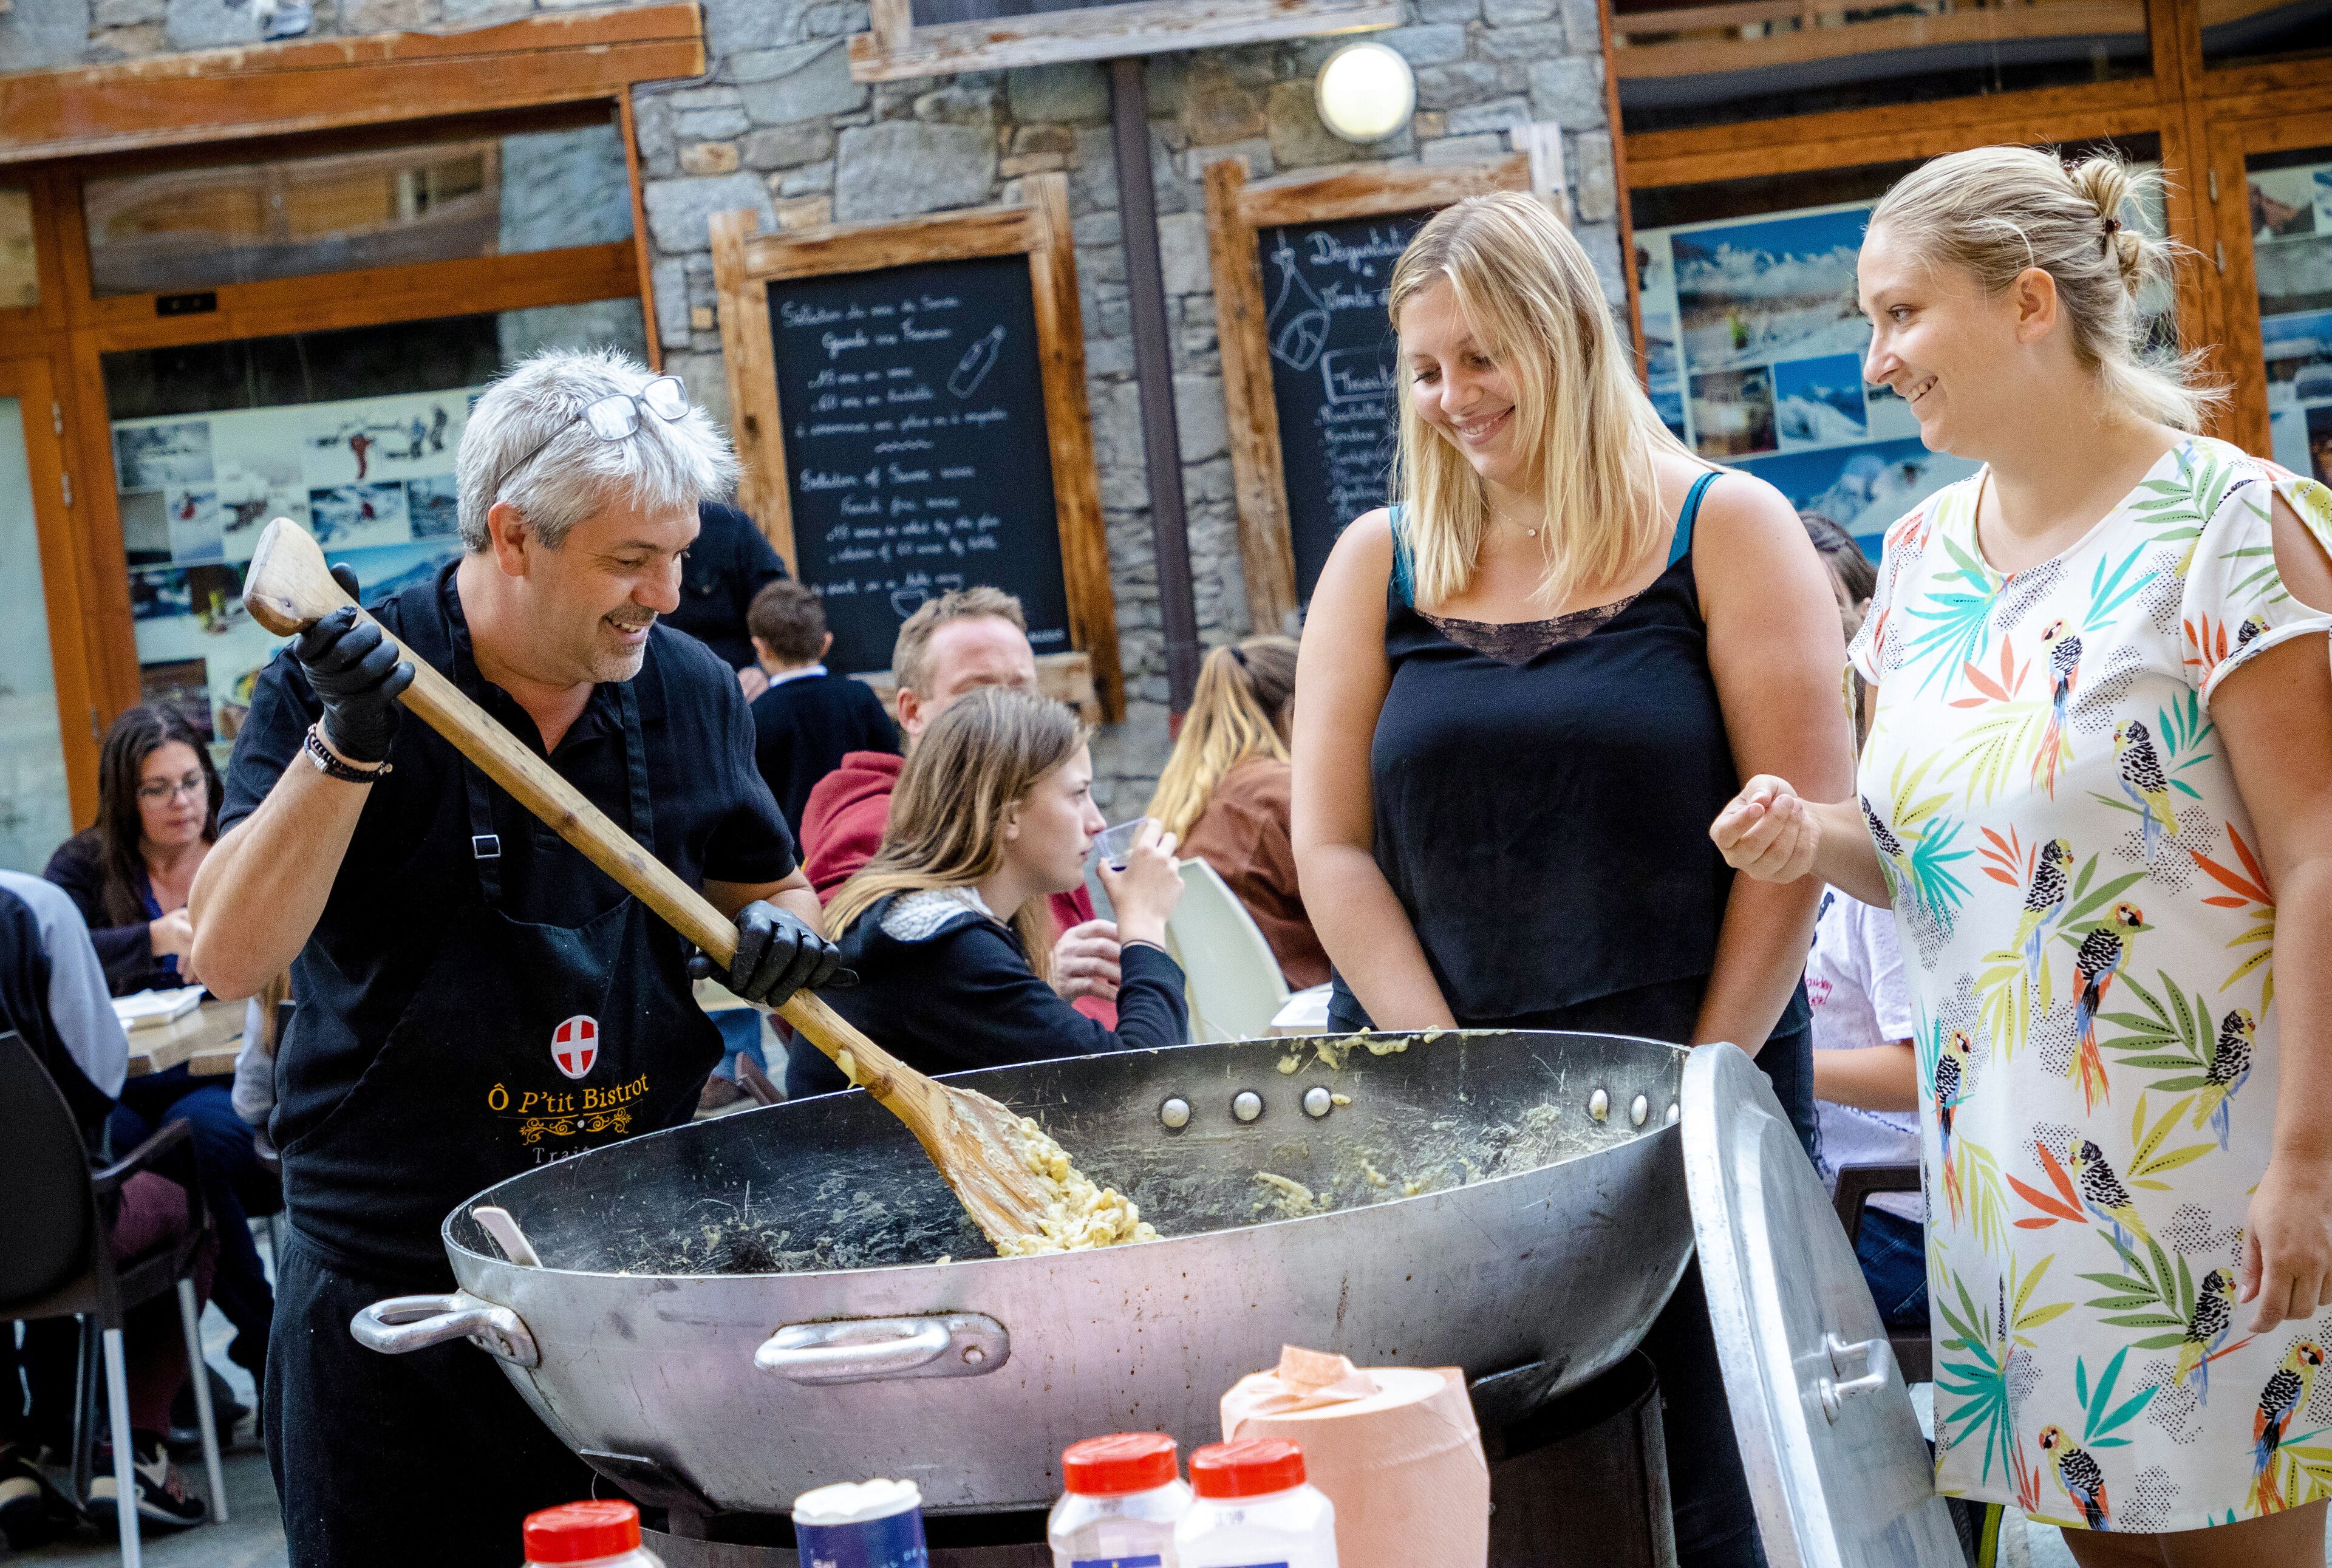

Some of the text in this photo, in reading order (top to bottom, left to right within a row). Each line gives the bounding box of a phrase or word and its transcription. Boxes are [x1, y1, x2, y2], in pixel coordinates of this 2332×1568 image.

[488, 1072, 650, 1114] Ô P'tit Bistrot
